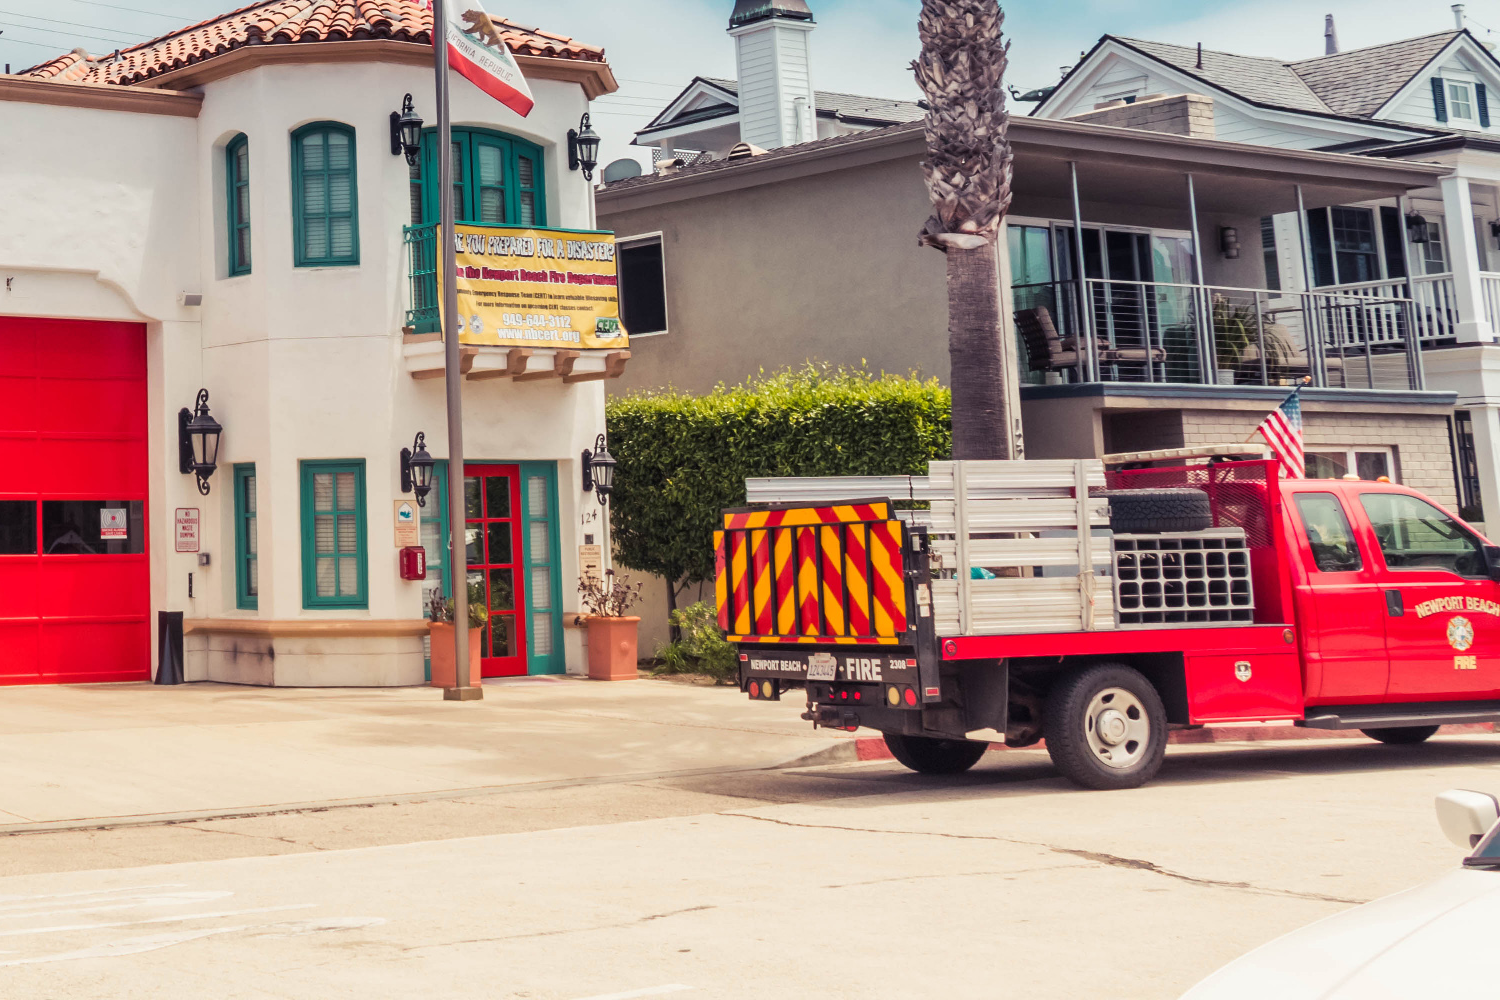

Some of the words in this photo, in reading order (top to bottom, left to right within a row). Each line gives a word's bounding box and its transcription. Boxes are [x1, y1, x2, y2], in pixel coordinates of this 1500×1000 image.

[479, 55, 514, 82] REPUBLIC
[466, 234, 486, 254] YOU
[488, 236, 534, 257] PREPARED
[537, 238, 554, 259] FOR
[556, 239, 565, 259] A
[567, 240, 614, 262] DISASTER?
[482, 266, 518, 282] Newport
[520, 269, 548, 282] Beach
[549, 270, 566, 284] Fire
[502, 312, 571, 328] 949-644-3112
[496, 328, 580, 342] www.nbcert.org
[581, 508, 598, 526] 124
[1414, 596, 1464, 618] NEWPORT
[1465, 596, 1500, 617] BEACH
[750, 659, 780, 671] NEWPORT
[780, 660, 802, 672] BEACH
[846, 658, 882, 682] FIRE
[890, 660, 906, 670] 2308
[1454, 655, 1477, 670] FIRE
